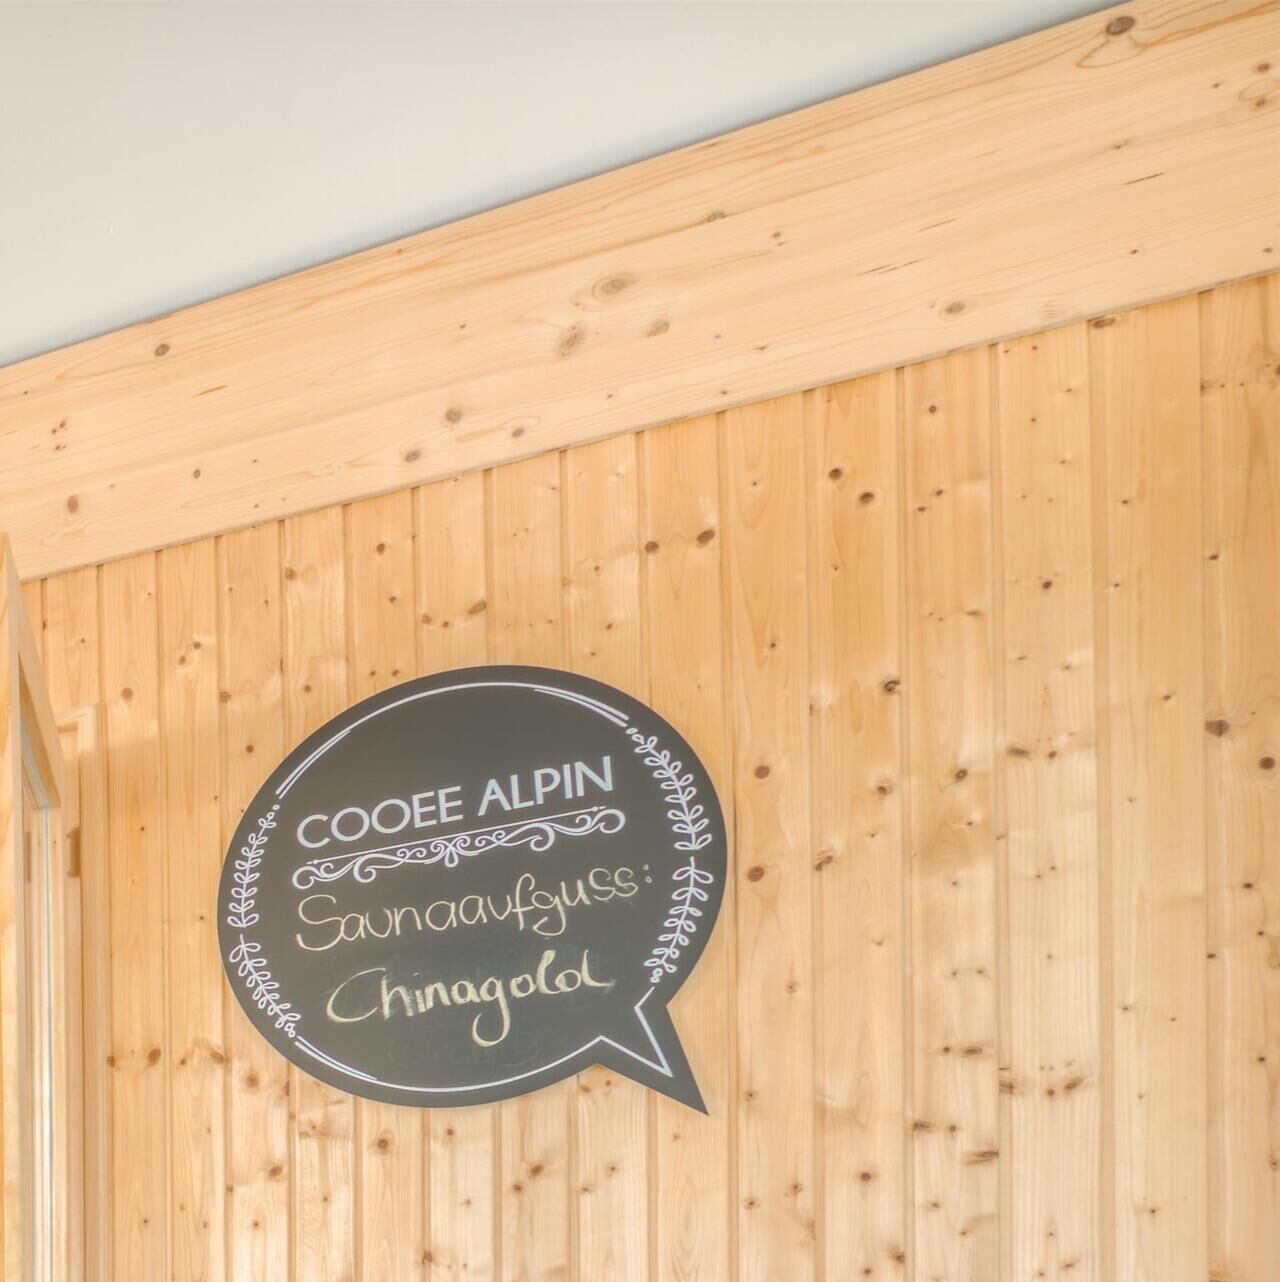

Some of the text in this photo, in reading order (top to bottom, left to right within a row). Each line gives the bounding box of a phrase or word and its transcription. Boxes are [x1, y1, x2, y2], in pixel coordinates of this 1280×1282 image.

[297, 755, 614, 849] COOEE ALPIN
[326, 949, 614, 1048] Chinagold
